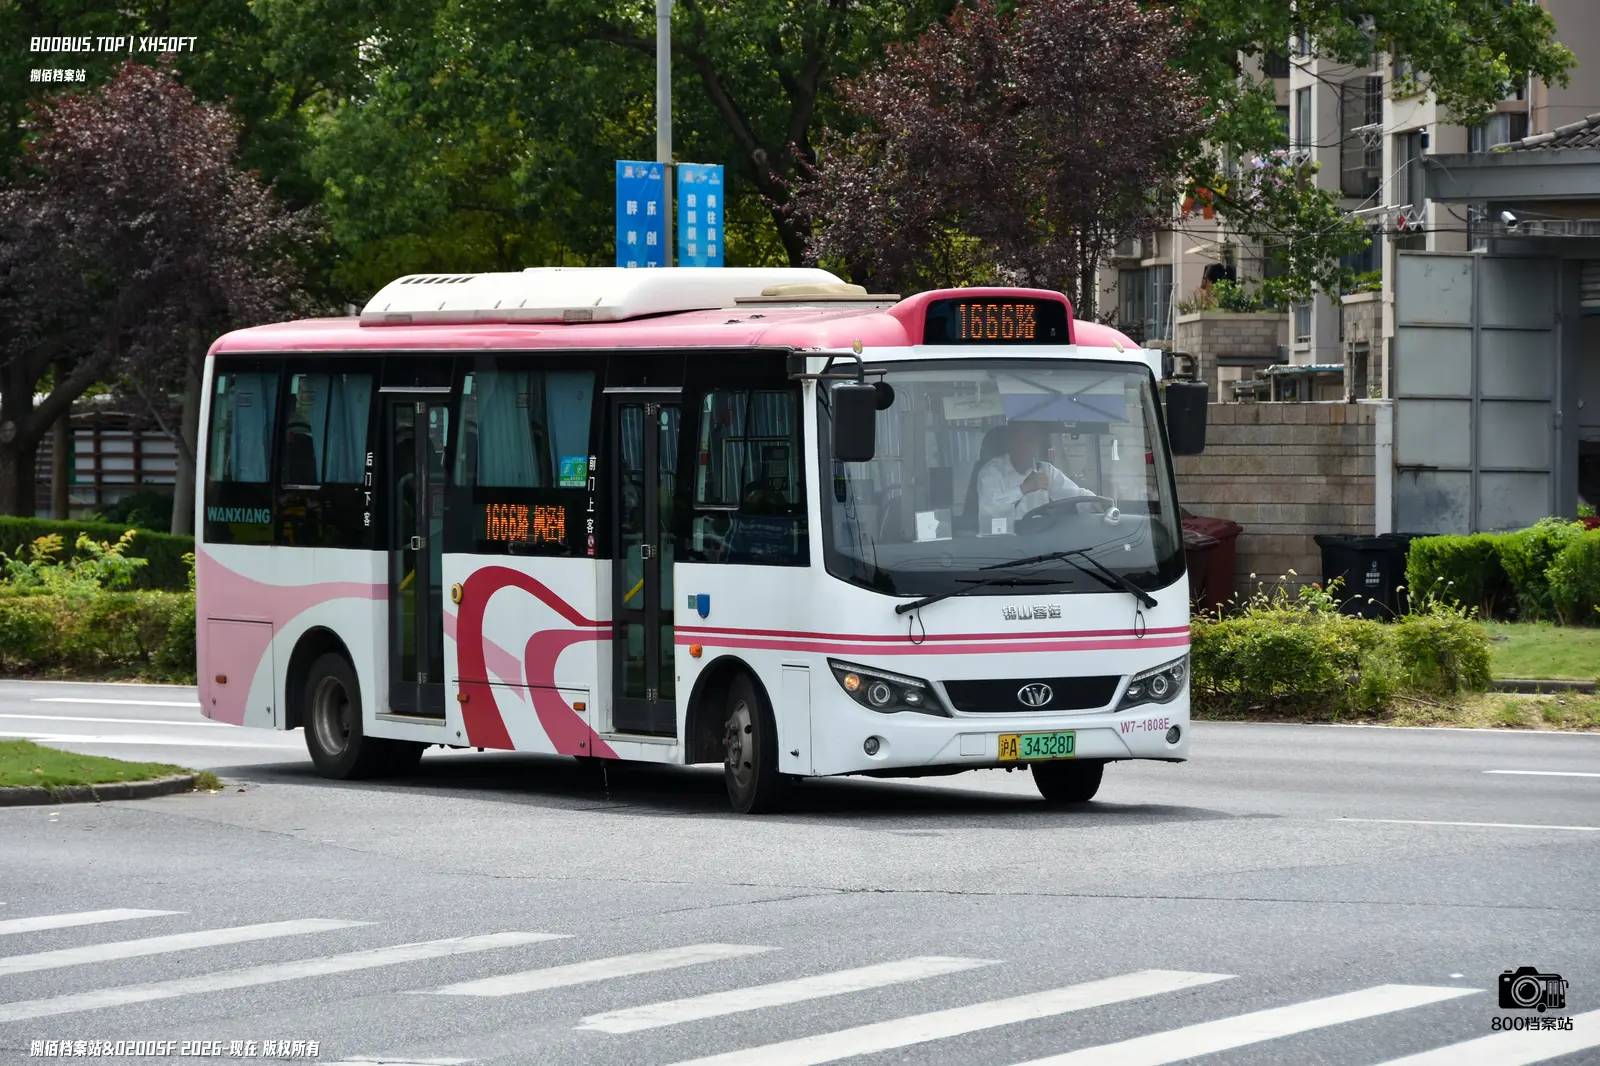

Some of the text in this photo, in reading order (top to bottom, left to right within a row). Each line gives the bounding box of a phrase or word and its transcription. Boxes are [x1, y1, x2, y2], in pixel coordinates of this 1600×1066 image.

[959, 304, 1036, 339] 1666路
[363, 452, 373, 527] 后门下客
[586, 454, 597, 534] 前门上客
[207, 506, 271, 524] WANXIANG
[485, 503, 529, 541] 1666路
[1120, 718, 1170, 734] W7-1808E
